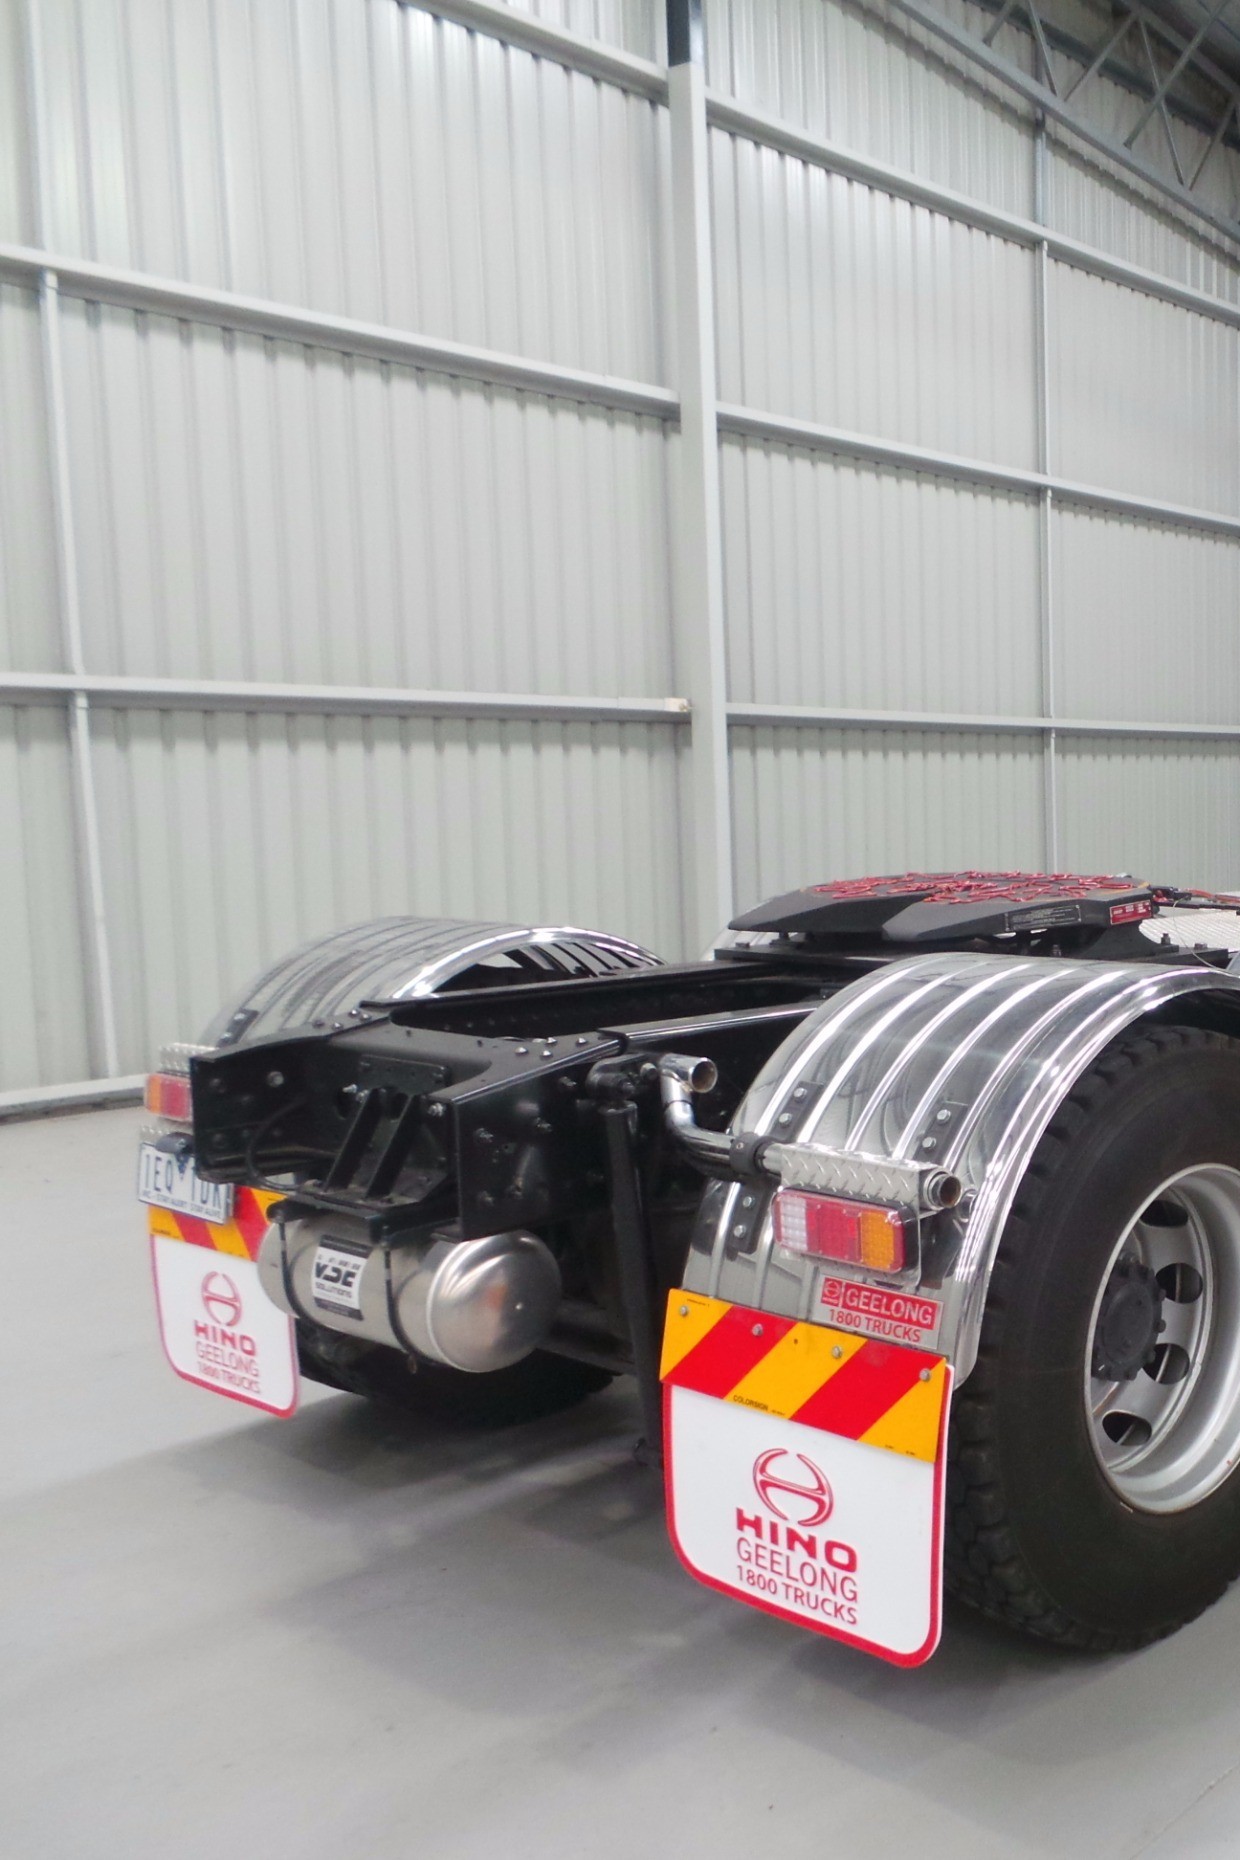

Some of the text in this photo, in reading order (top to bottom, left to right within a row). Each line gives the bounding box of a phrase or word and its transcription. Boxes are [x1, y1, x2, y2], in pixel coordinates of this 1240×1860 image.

[845, 1287, 933, 1325] GEELONG
[194, 1319, 256, 1357] HINO
[829, 1308, 921, 1343] 1800 TRUCKS
[196, 1340, 259, 1377] GEELONG
[197, 1360, 262, 1394] 1800 TRUCKS
[736, 1506, 857, 1574] HINO
[737, 1537, 858, 1603] GEELONG
[737, 1565, 857, 1625] 1800 TRUCKS
